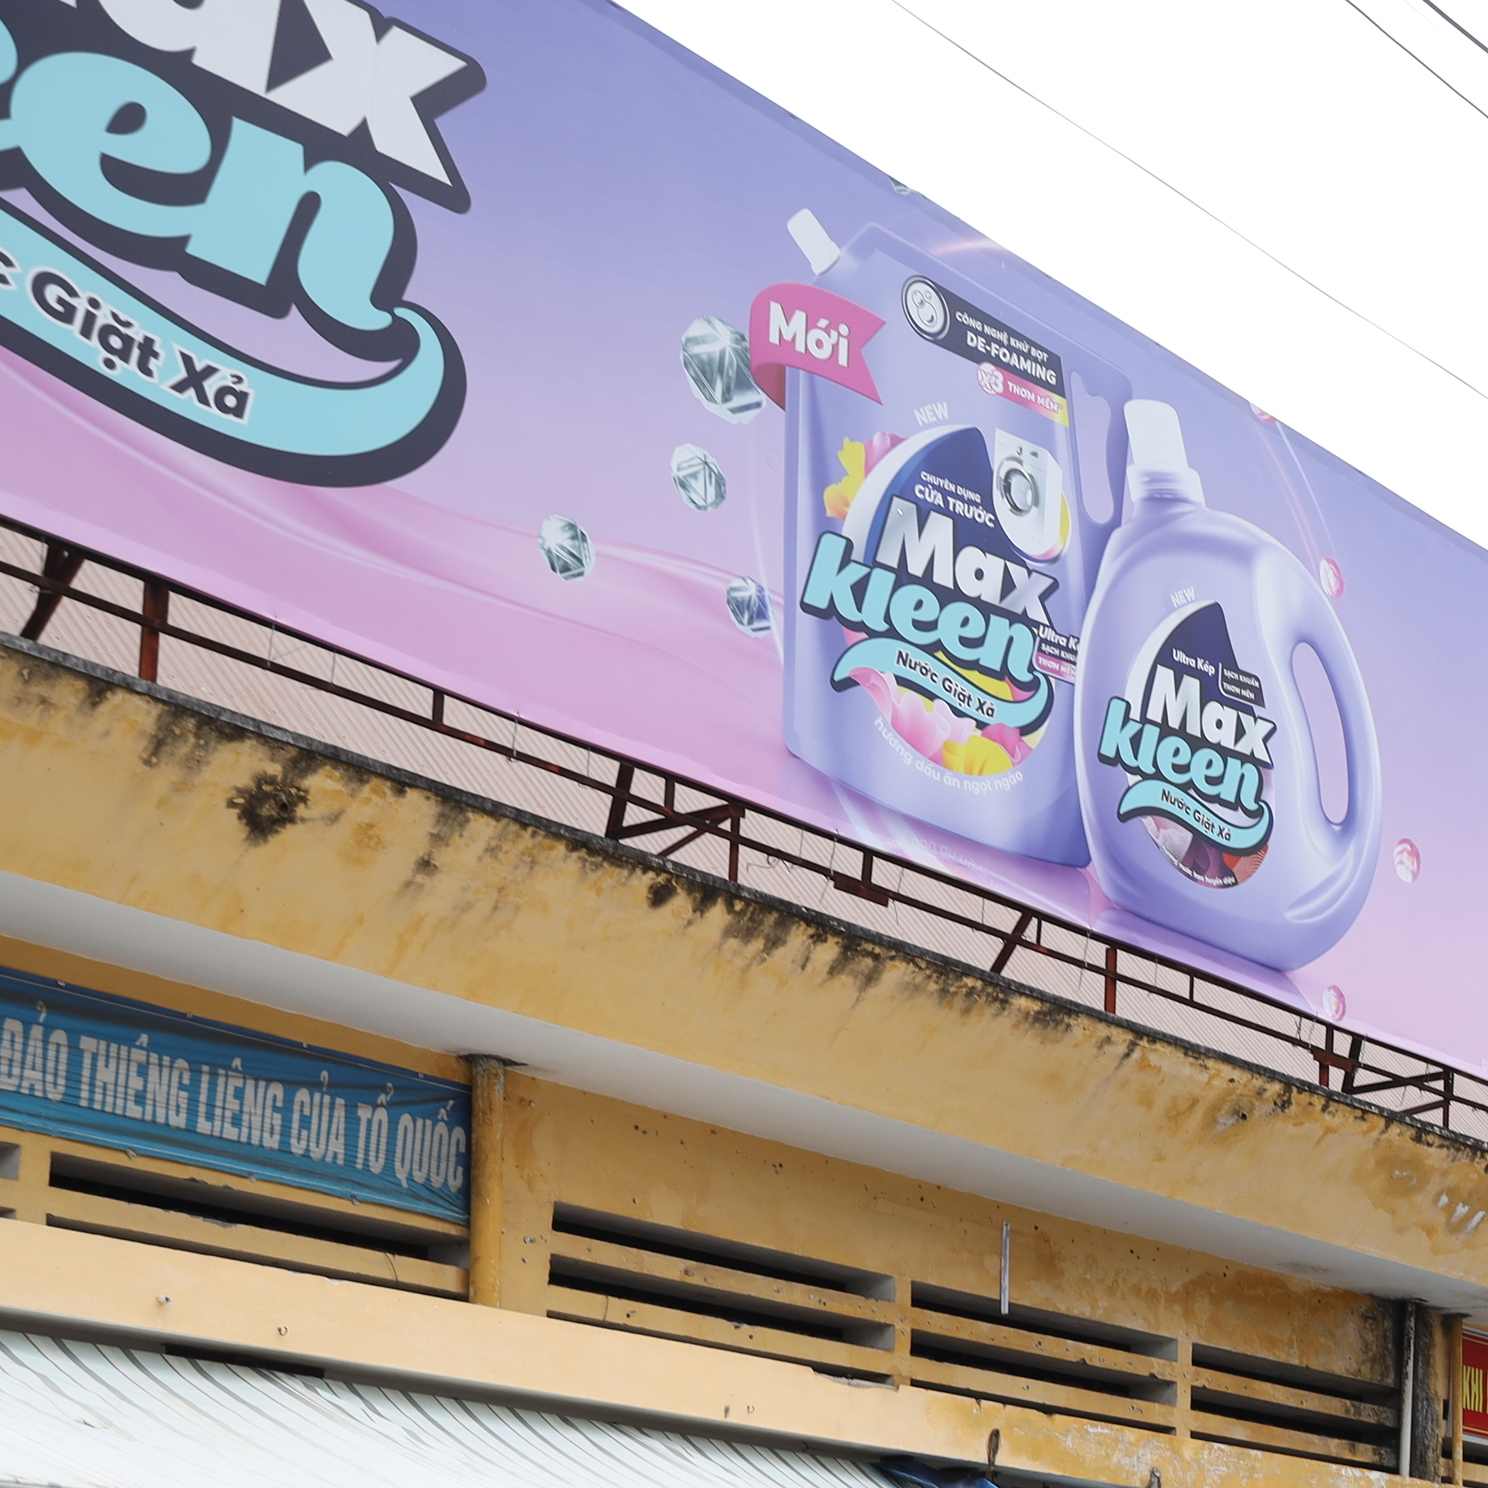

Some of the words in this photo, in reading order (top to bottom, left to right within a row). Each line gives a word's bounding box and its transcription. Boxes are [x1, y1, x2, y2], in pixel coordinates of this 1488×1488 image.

[32, 270, 163, 371] Giặt
[170, 350, 252, 420] Xả
[769, 300, 849, 367] Mới
[956, 310, 982, 332] CÔNG
[983, 320, 1009, 345] NGHỆ
[966, 331, 1057, 385] DE-FOAMING
[914, 402, 949, 426] NEW
[915, 484, 945, 508] CỬA
[947, 494, 995, 528] TRƯỚC
[921, 470, 955, 494] CHUYÊN
[957, 485, 981, 504] DỤNG
[875, 496, 1054, 625] Max
[802, 533, 1036, 682] kleen
[1170, 586, 1196, 608] NEW
[896, 650, 939, 684] Nước
[941, 677, 973, 708] Giặt
[975, 696, 995, 718] Xả
[1172, 648, 1196, 667] Ultra
[1197, 657, 1215, 677] Kép
[1146, 664, 1275, 764] Max
[874, 716, 914, 766] hương
[914, 758, 941, 781] dấu
[942, 769, 960, 789] ấn
[963, 777, 993, 796] ngọt
[994, 769, 1024, 793] ngào
[1100, 698, 1259, 811] kleen
[1161, 788, 1191, 816] Nước
[1192, 809, 1216, 834] Giặt
[1217, 824, 1232, 842] Xả
[79, 1033, 190, 1130] THIÊNG
[196, 1057, 283, 1150] LIÊNG
[290, 1069, 346, 1166] CỦA
[356, 1082, 395, 1175] TỔ
[395, 1101, 466, 1194] QUỐC
[1463, 1365, 1483, 1413] KHI
